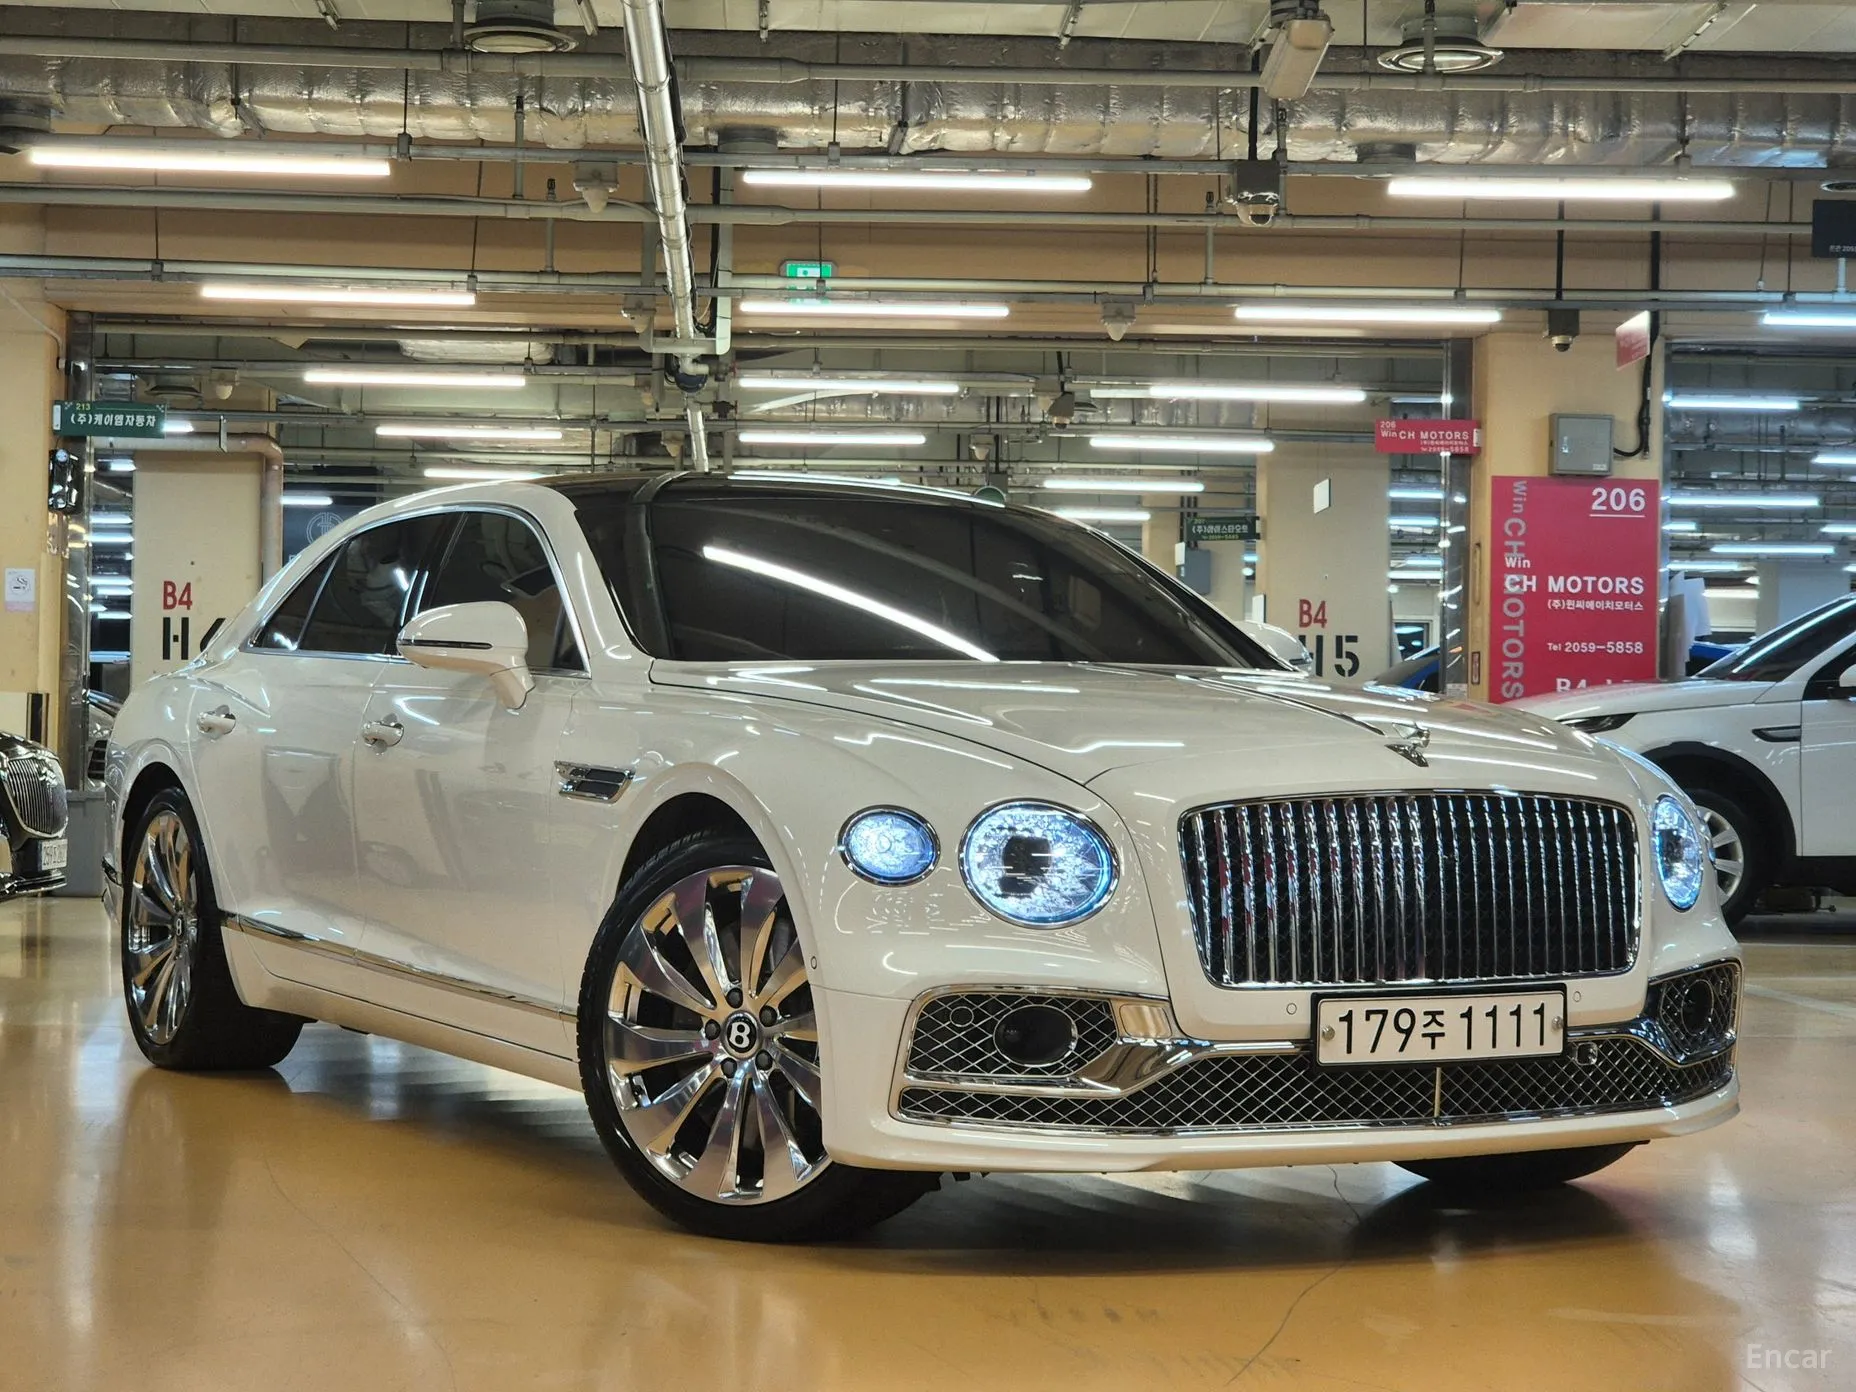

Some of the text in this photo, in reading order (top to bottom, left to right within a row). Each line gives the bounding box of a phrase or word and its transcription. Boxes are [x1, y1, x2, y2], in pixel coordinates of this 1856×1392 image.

[76, 403, 91, 411] 213
[1380, 421, 1396, 429] 206
[1381, 430, 1469, 440] Win CH MOTORS
[1512, 480, 1528, 513] Win
[1591, 487, 1646, 512] 206
[1504, 556, 1531, 569] Win
[162, 580, 193, 610] B4
[1504, 575, 1645, 595] CH MOTORS
[1299, 599, 1328, 628] B4
[1547, 641, 1644, 654] Tel 2059-5858
[1338, 1002, 1545, 1055] 179주 1111
